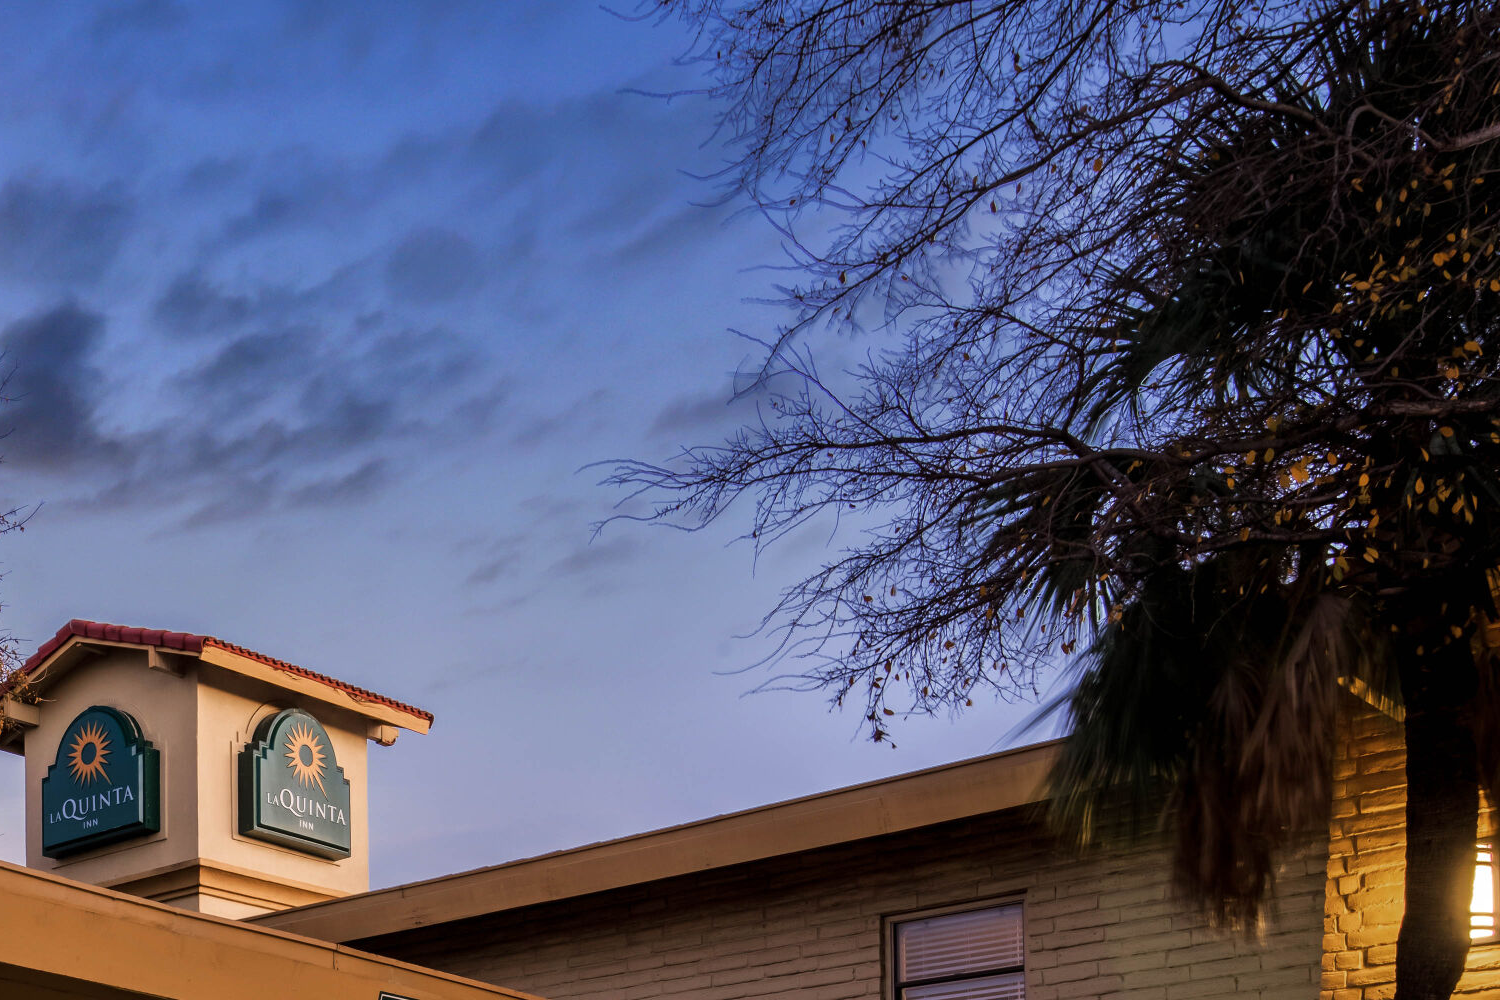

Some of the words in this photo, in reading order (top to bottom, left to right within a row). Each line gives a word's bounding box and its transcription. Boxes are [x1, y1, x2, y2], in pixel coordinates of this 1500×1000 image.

[50, 811, 62, 824] LA
[62, 785, 134, 820] QUINTA
[267, 792, 280, 806] LA
[280, 788, 347, 826] QUINTA
[83, 818, 99, 829] INN
[299, 820, 314, 831] INN
